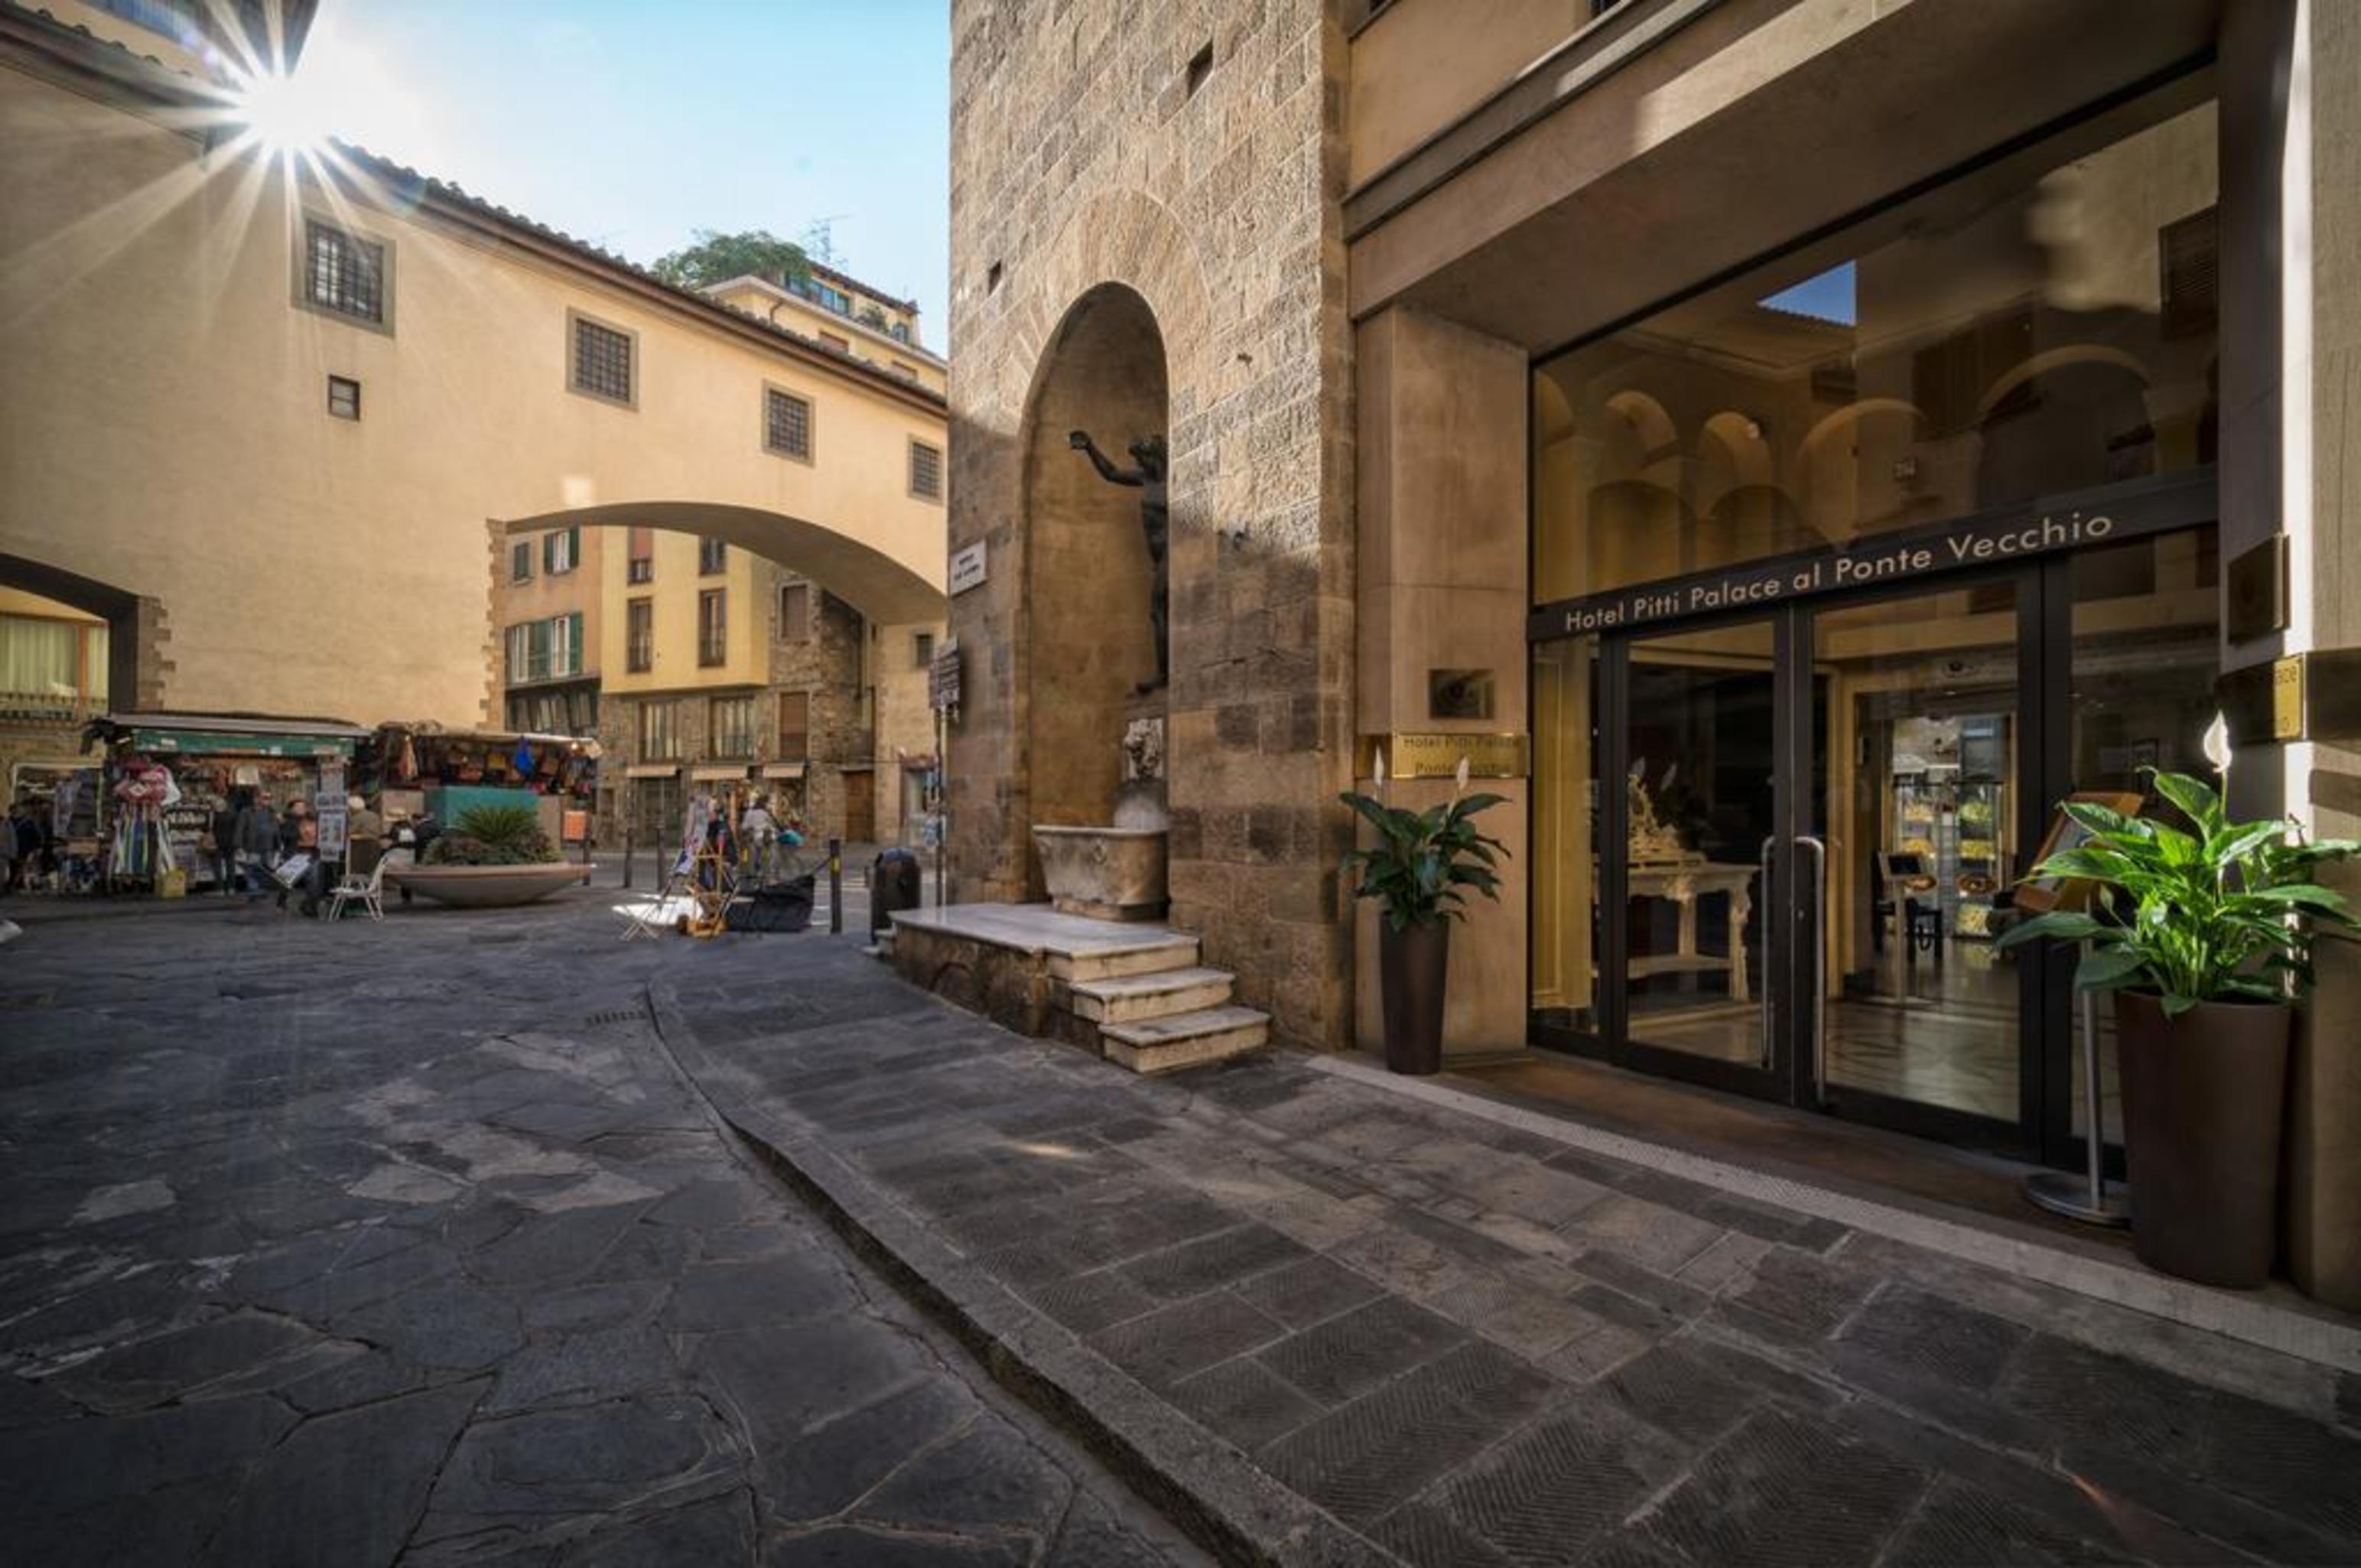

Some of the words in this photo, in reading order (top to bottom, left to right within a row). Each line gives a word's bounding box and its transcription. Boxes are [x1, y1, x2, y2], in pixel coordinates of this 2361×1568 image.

[1566, 602, 1624, 631] Hotel
[1634, 592, 1680, 620] Pitti
[1691, 578, 1781, 609] Palace
[1792, 562, 1820, 591] al
[1836, 548, 1933, 583] Ponte
[1946, 512, 2112, 561] Vecchio
[1403, 737, 1440, 748] Hotel
